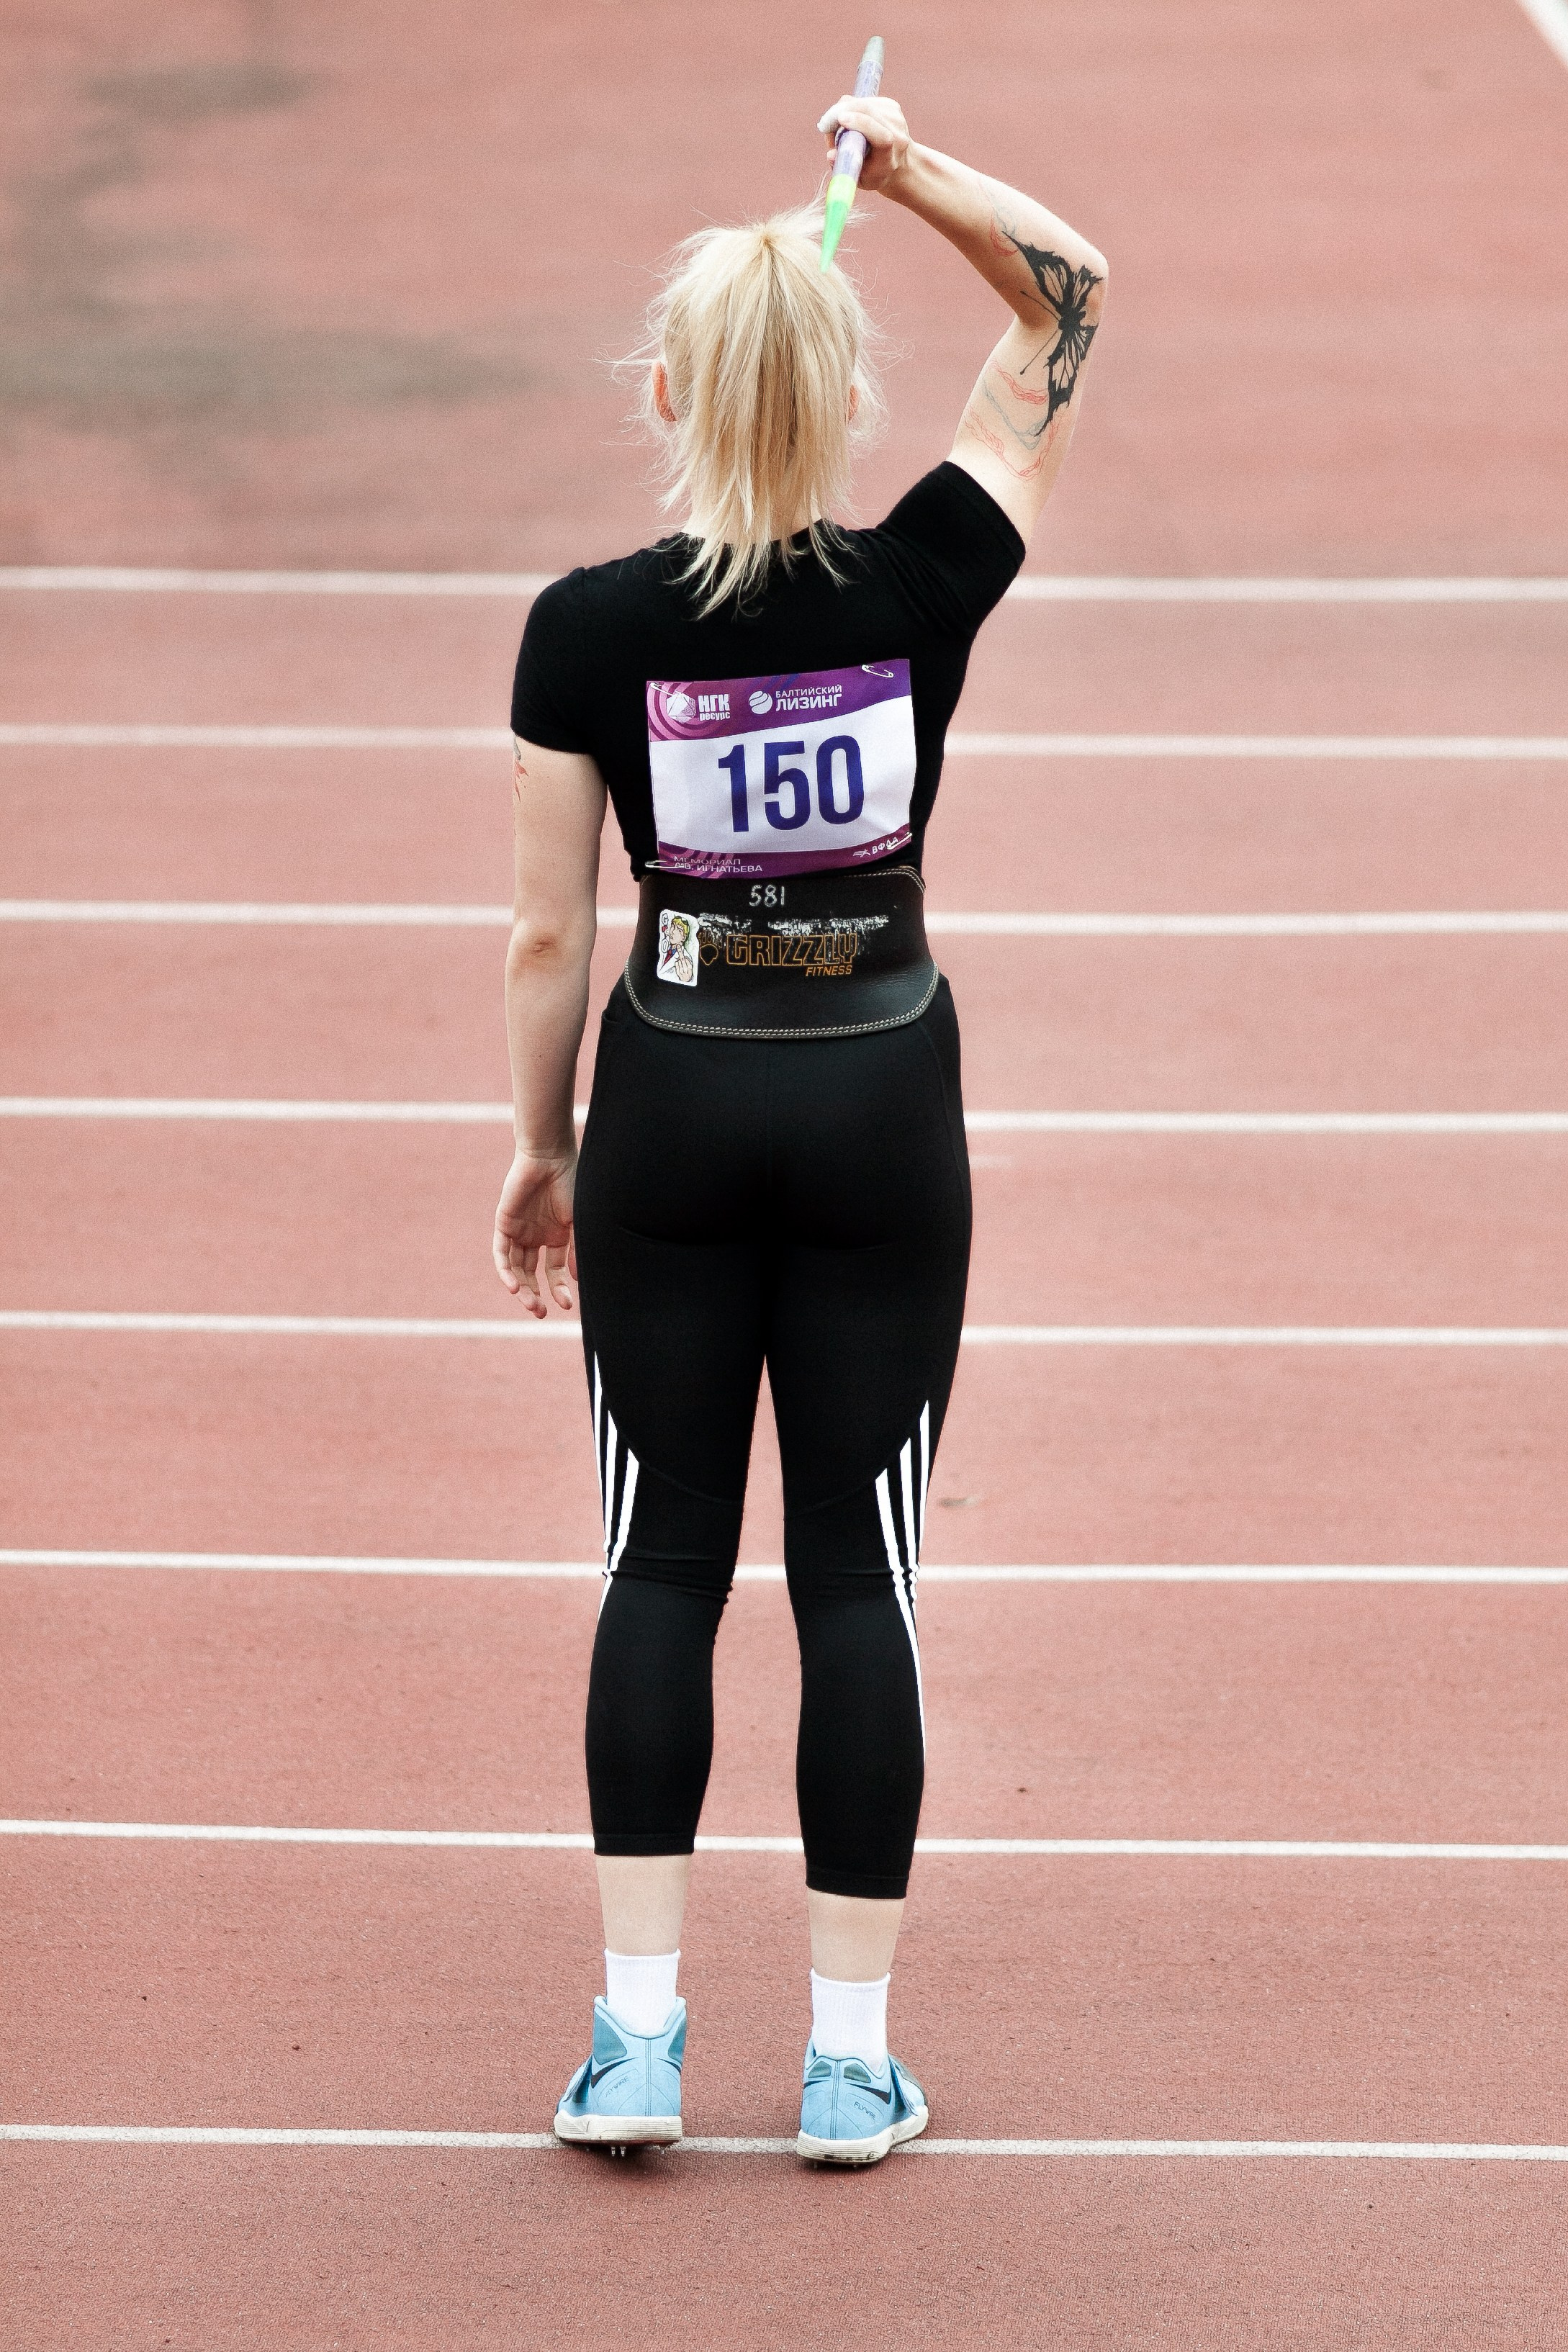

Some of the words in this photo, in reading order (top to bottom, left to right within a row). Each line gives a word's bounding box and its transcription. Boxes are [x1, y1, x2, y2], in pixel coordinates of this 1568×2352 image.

[775, 684, 842, 698] БАЛТИЙСКИЙ
[698, 693, 731, 712] НГК
[775, 694, 843, 711] ЛИЗИНГ
[699, 711, 731, 721] ресурс
[718, 735, 865, 834] 150
[696, 864, 763, 873] ИГНАТЬЕВА
[749, 884, 785, 907] 581
[726, 932, 858, 967] GRIZZLY
[805, 965, 853, 977] FITNESS
